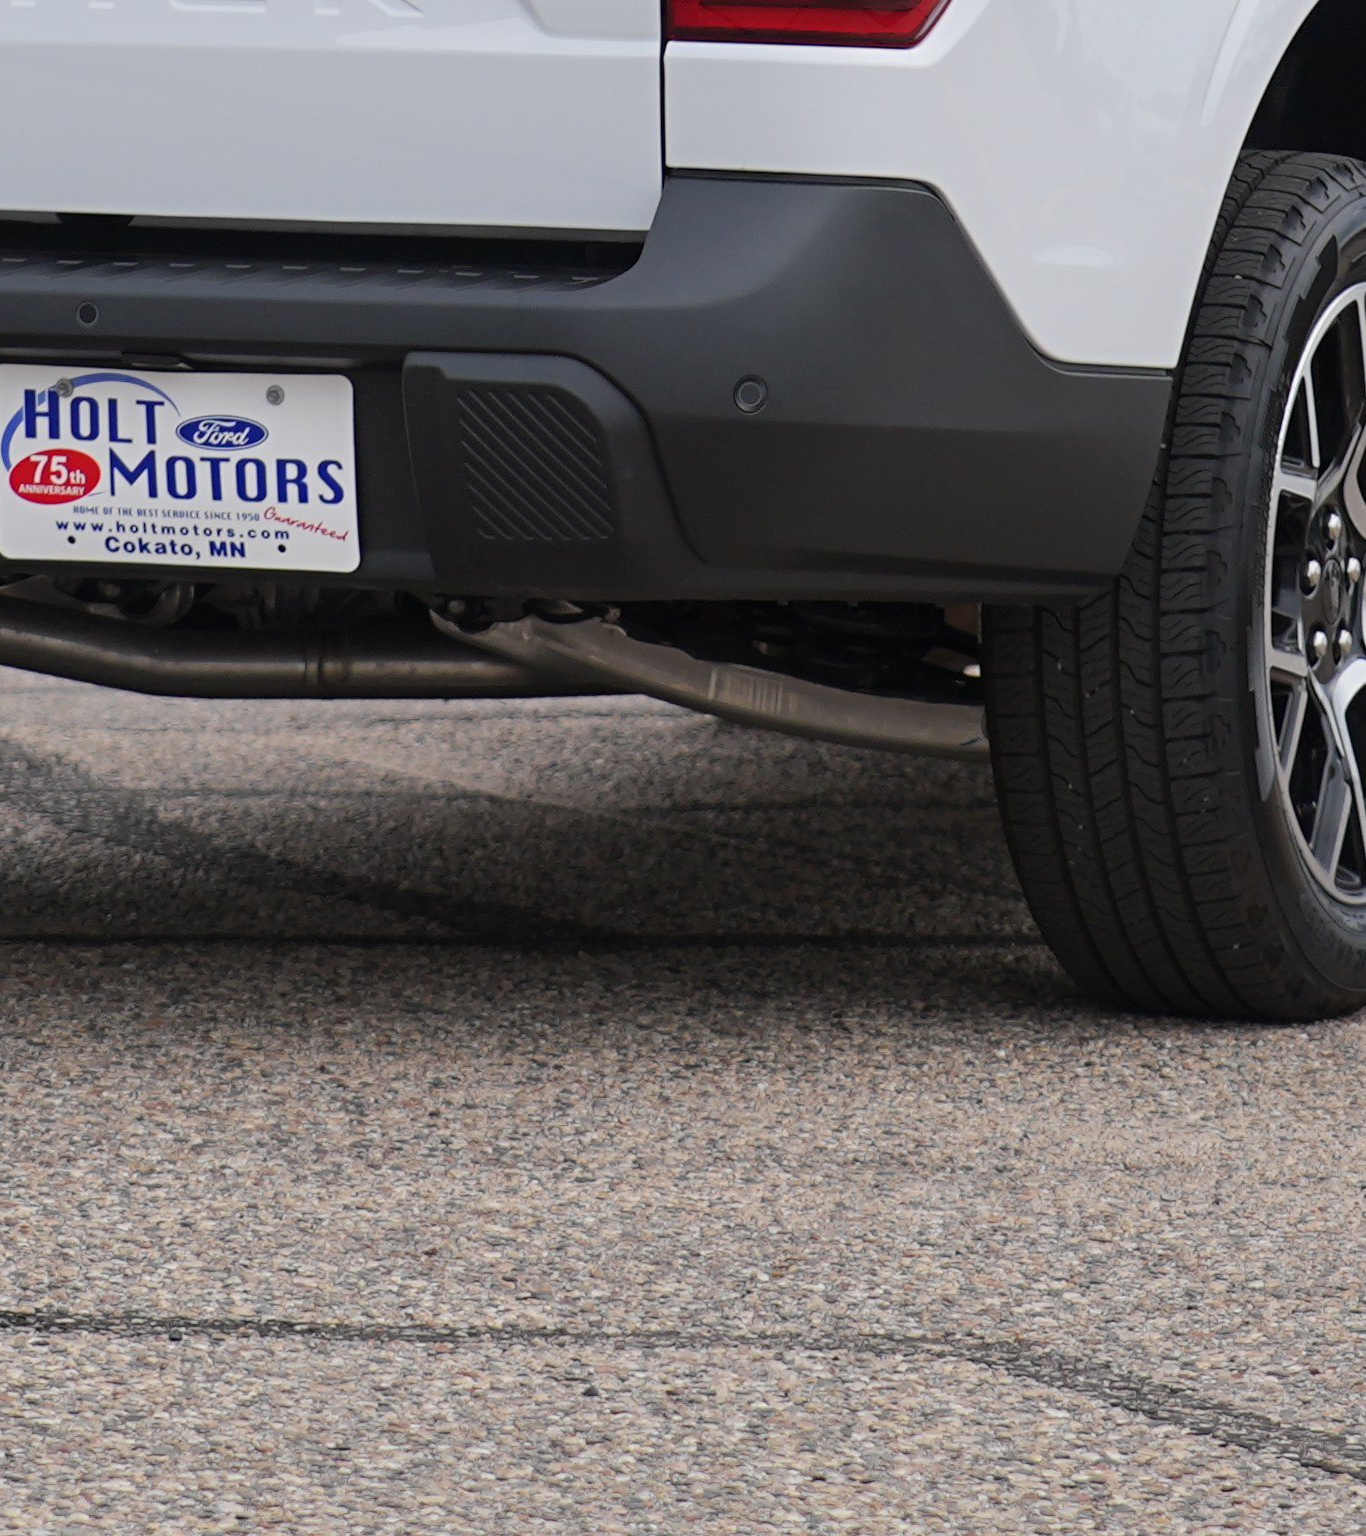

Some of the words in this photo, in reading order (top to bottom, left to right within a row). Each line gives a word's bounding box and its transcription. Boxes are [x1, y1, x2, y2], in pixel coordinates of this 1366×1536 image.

[23, 389, 166, 446] HOLT
[192, 420, 252, 447] Ford
[29, 454, 86, 485] 75th
[108, 448, 345, 505] MOTORS
[18, 484, 85, 496] ANNIVERSARY
[73, 505, 99, 515] HOME
[103, 506, 113, 516] OF
[117, 507, 132, 517] THE
[137, 508, 158, 518] BEST
[162, 510, 201, 520] SERVICE
[204, 510, 232, 521] SINCE
[236, 511, 260, 522] 1950
[263, 505, 349, 542] Guaranteed
[55, 521, 290, 540] www.holtmotors.com
[104, 535, 201, 560] Cokato,
[208, 541, 246, 558] MN
